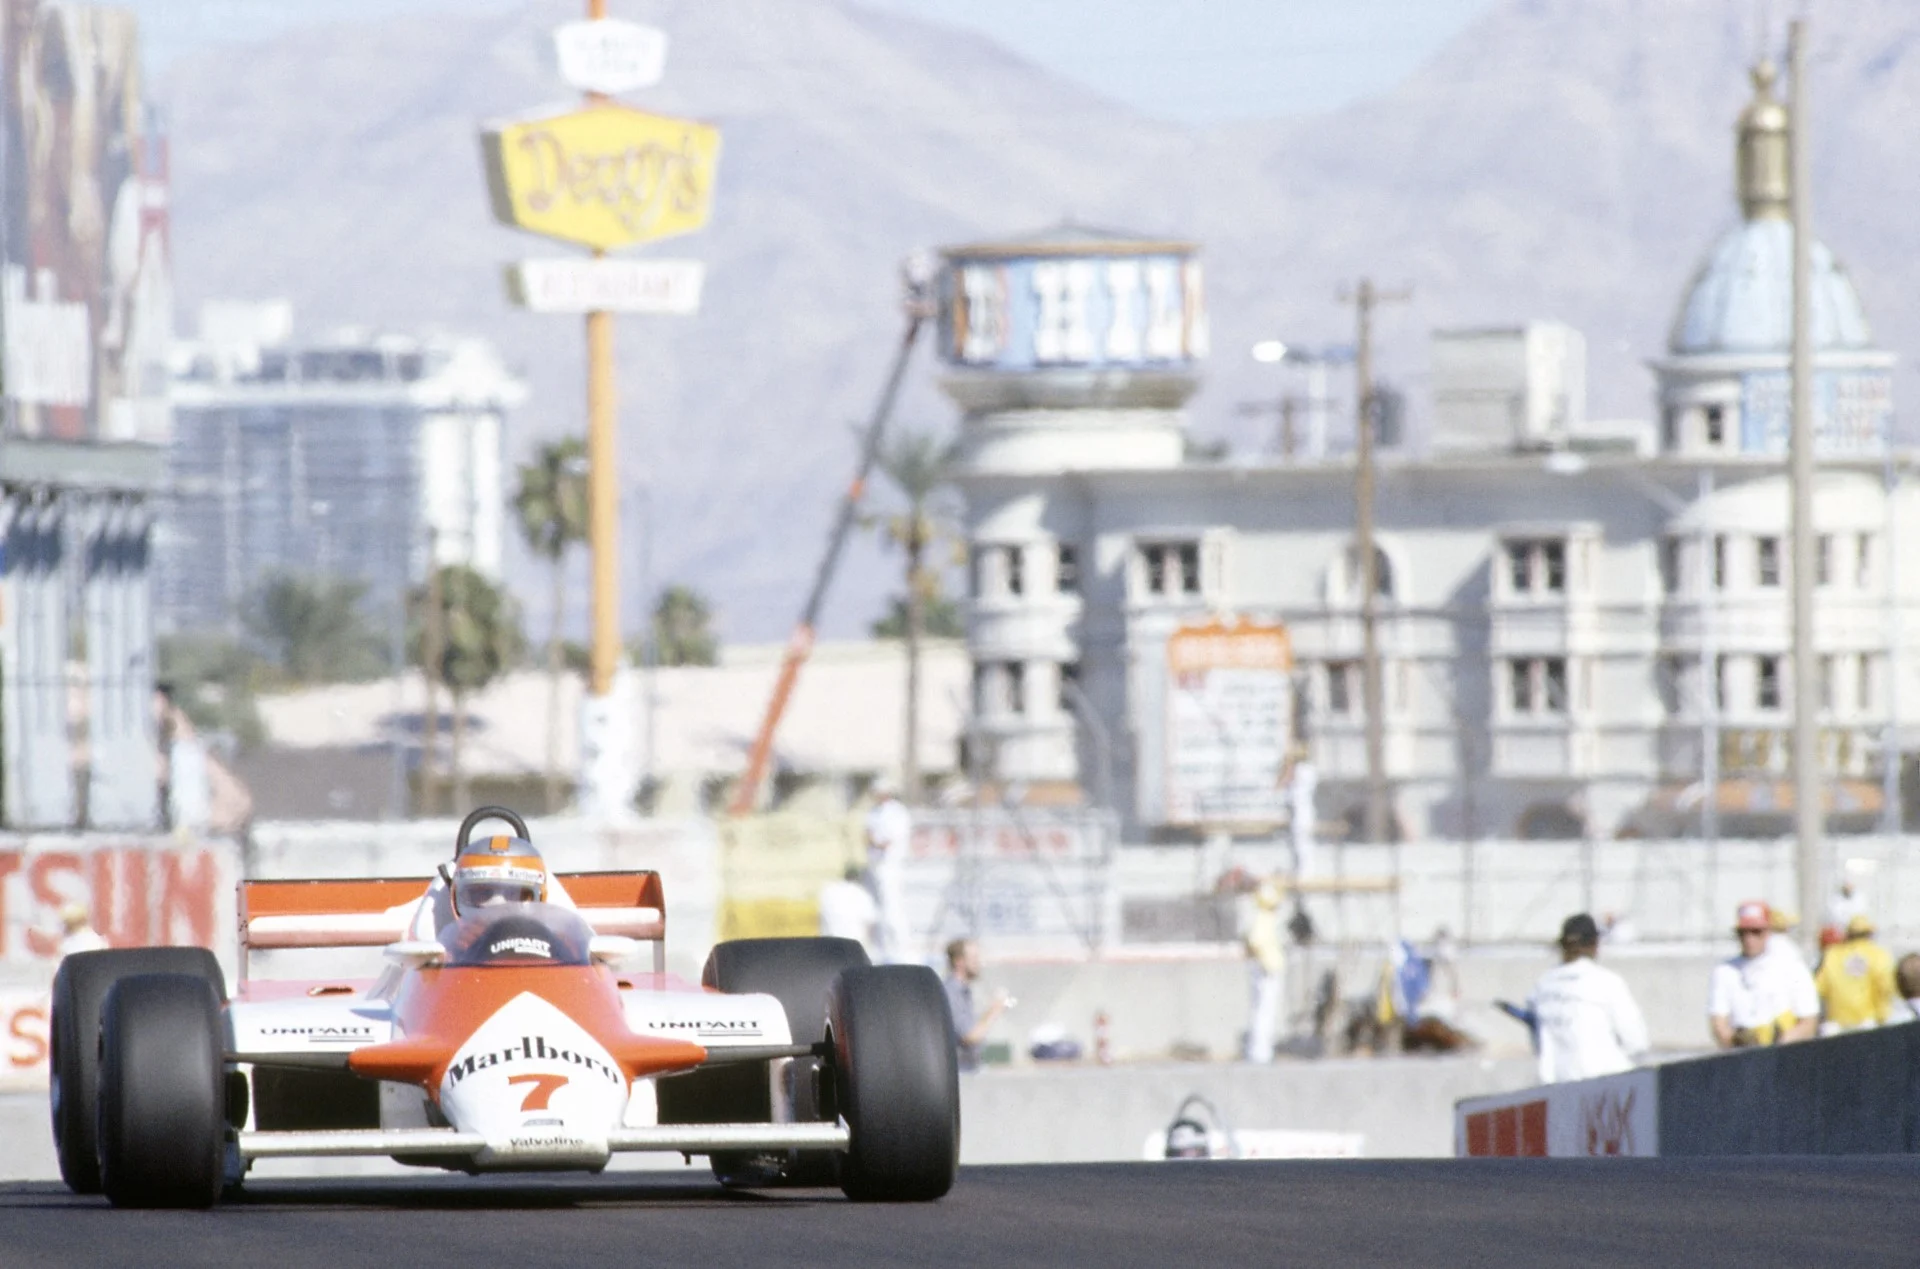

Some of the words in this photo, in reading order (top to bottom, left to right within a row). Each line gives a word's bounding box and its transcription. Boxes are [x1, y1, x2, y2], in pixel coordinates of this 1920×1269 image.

[490, 937, 552, 955] UNIPART
[260, 1026, 373, 1037] UNIPART
[649, 1020, 759, 1031] UNIPART
[448, 1035, 619, 1089] Marlboro
[507, 1072, 570, 1112] 7
[509, 1135, 585, 1148] Valvoline
